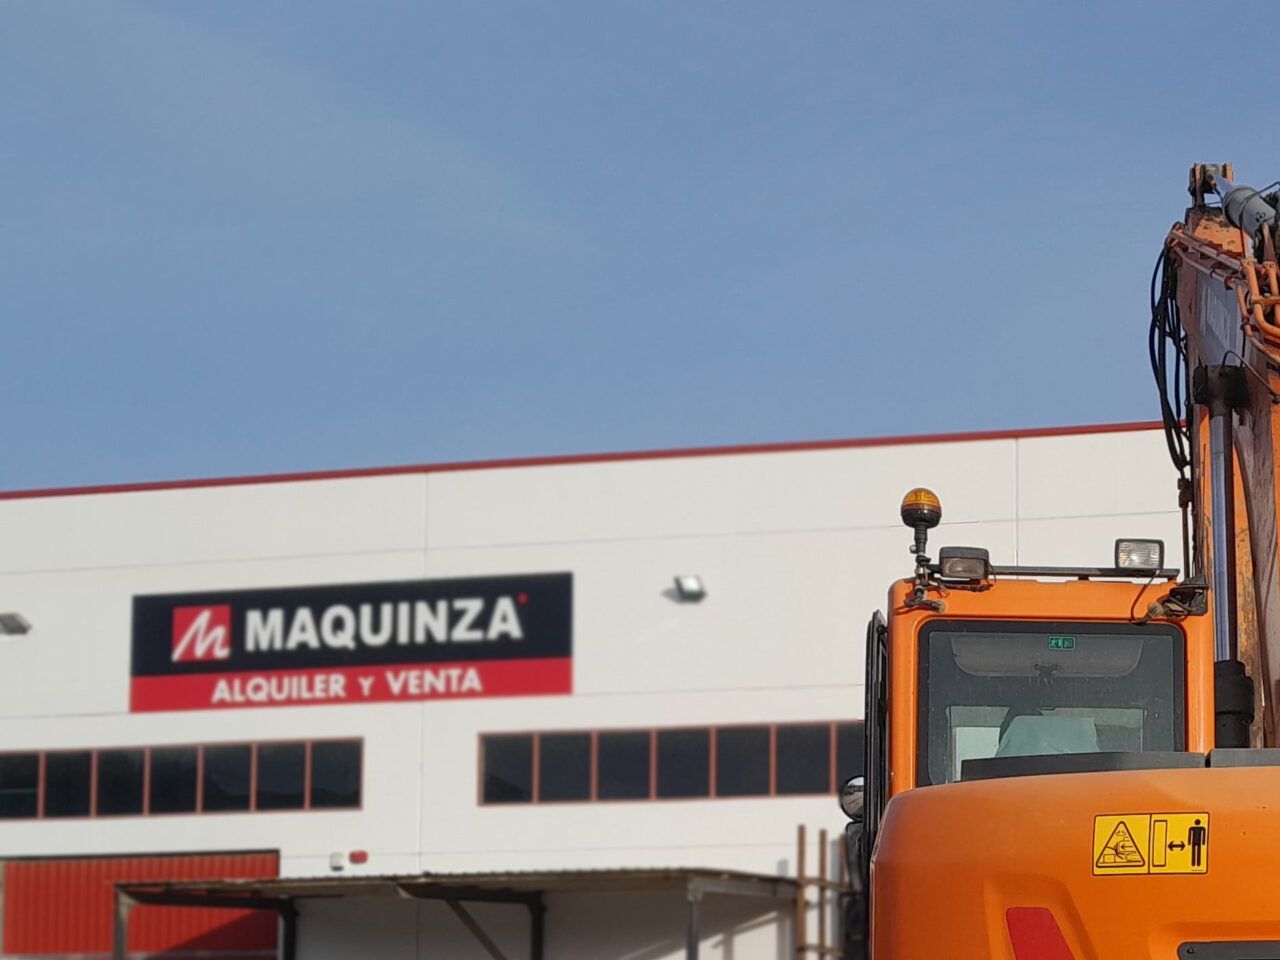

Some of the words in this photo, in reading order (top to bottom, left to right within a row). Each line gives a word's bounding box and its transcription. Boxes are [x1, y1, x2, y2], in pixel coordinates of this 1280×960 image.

[245, 597, 523, 652] MAQUINZA
[212, 674, 346, 703] ALQUILER
[358, 677, 375, 697] Y
[386, 668, 482, 695] VENTA
